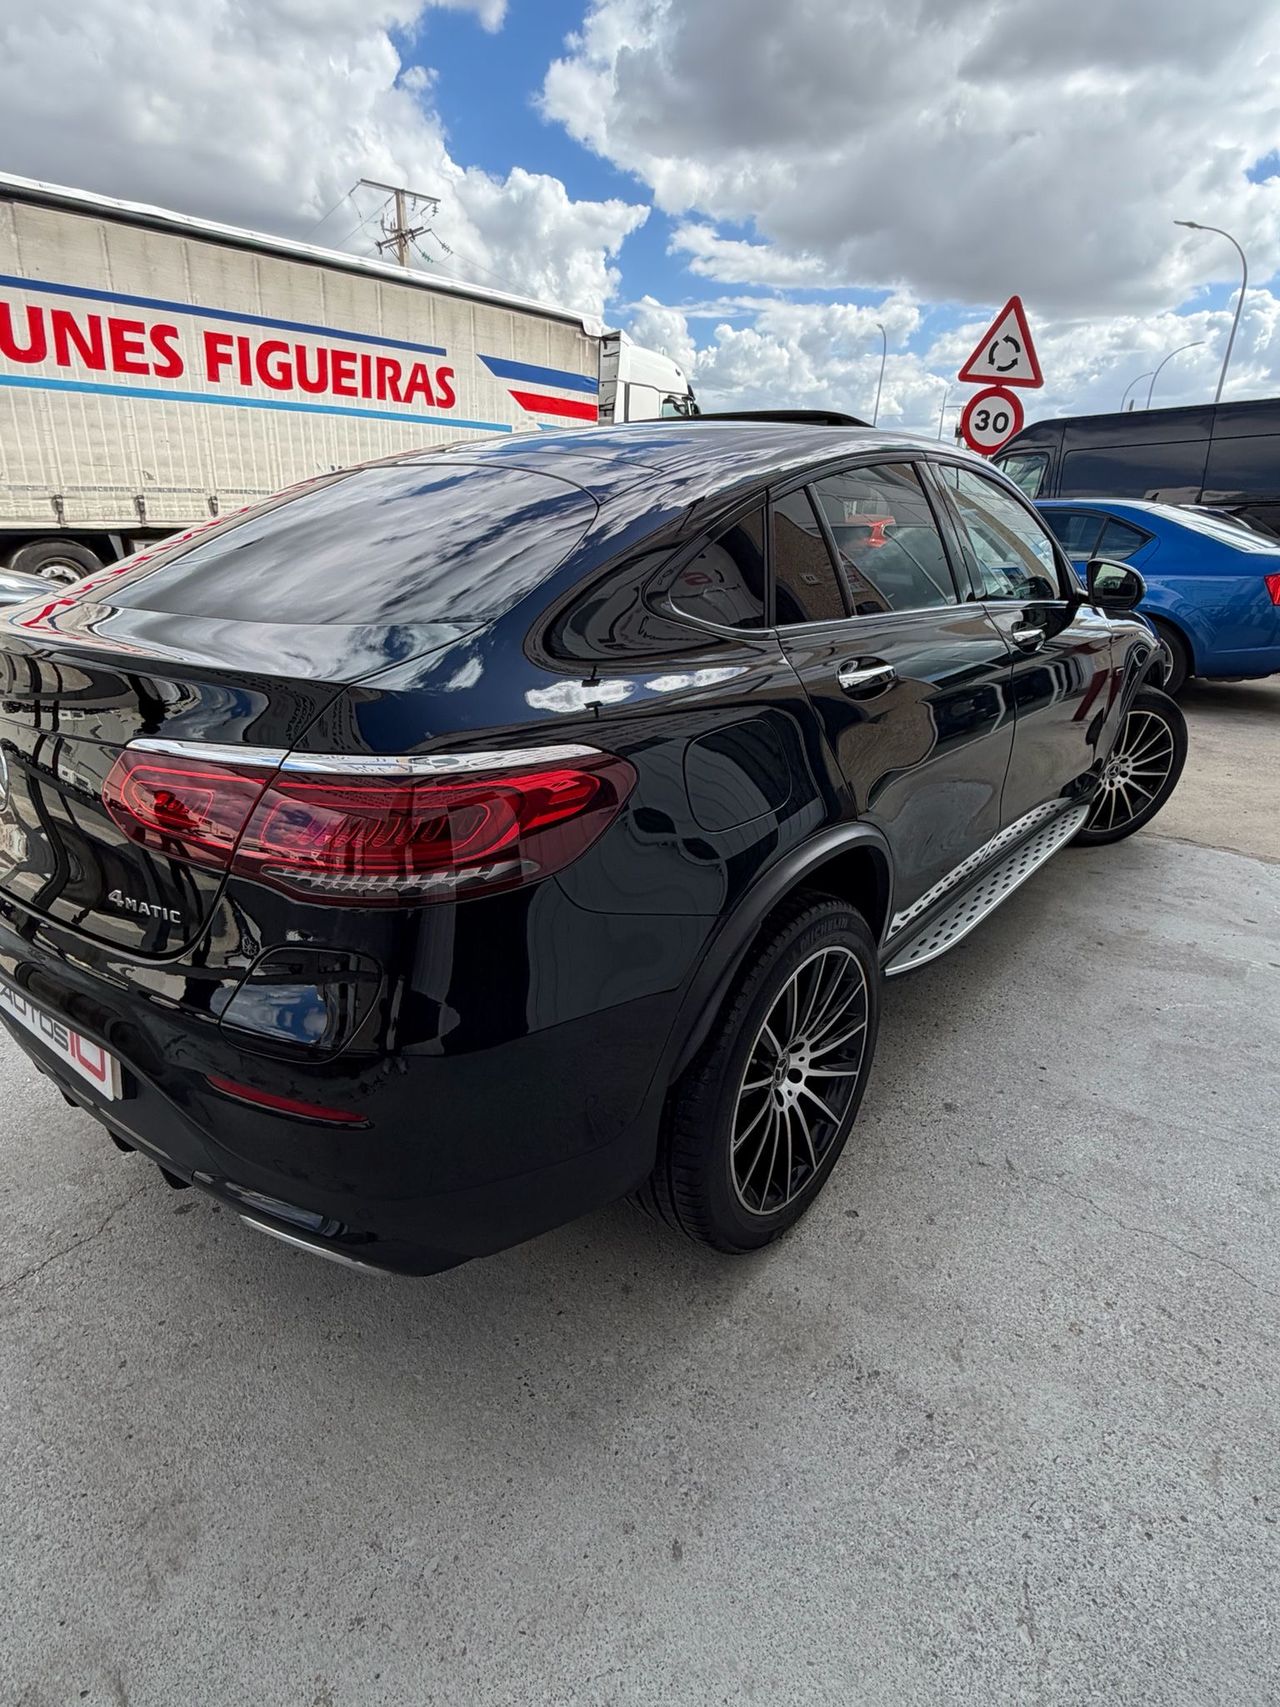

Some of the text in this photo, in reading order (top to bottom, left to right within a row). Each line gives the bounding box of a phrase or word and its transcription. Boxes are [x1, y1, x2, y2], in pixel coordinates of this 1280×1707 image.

[0, 302, 456, 409] UNES FIGUEIRAS
[974, 409, 1010, 434] 30
[108, 889, 181, 924] 4MATIC
